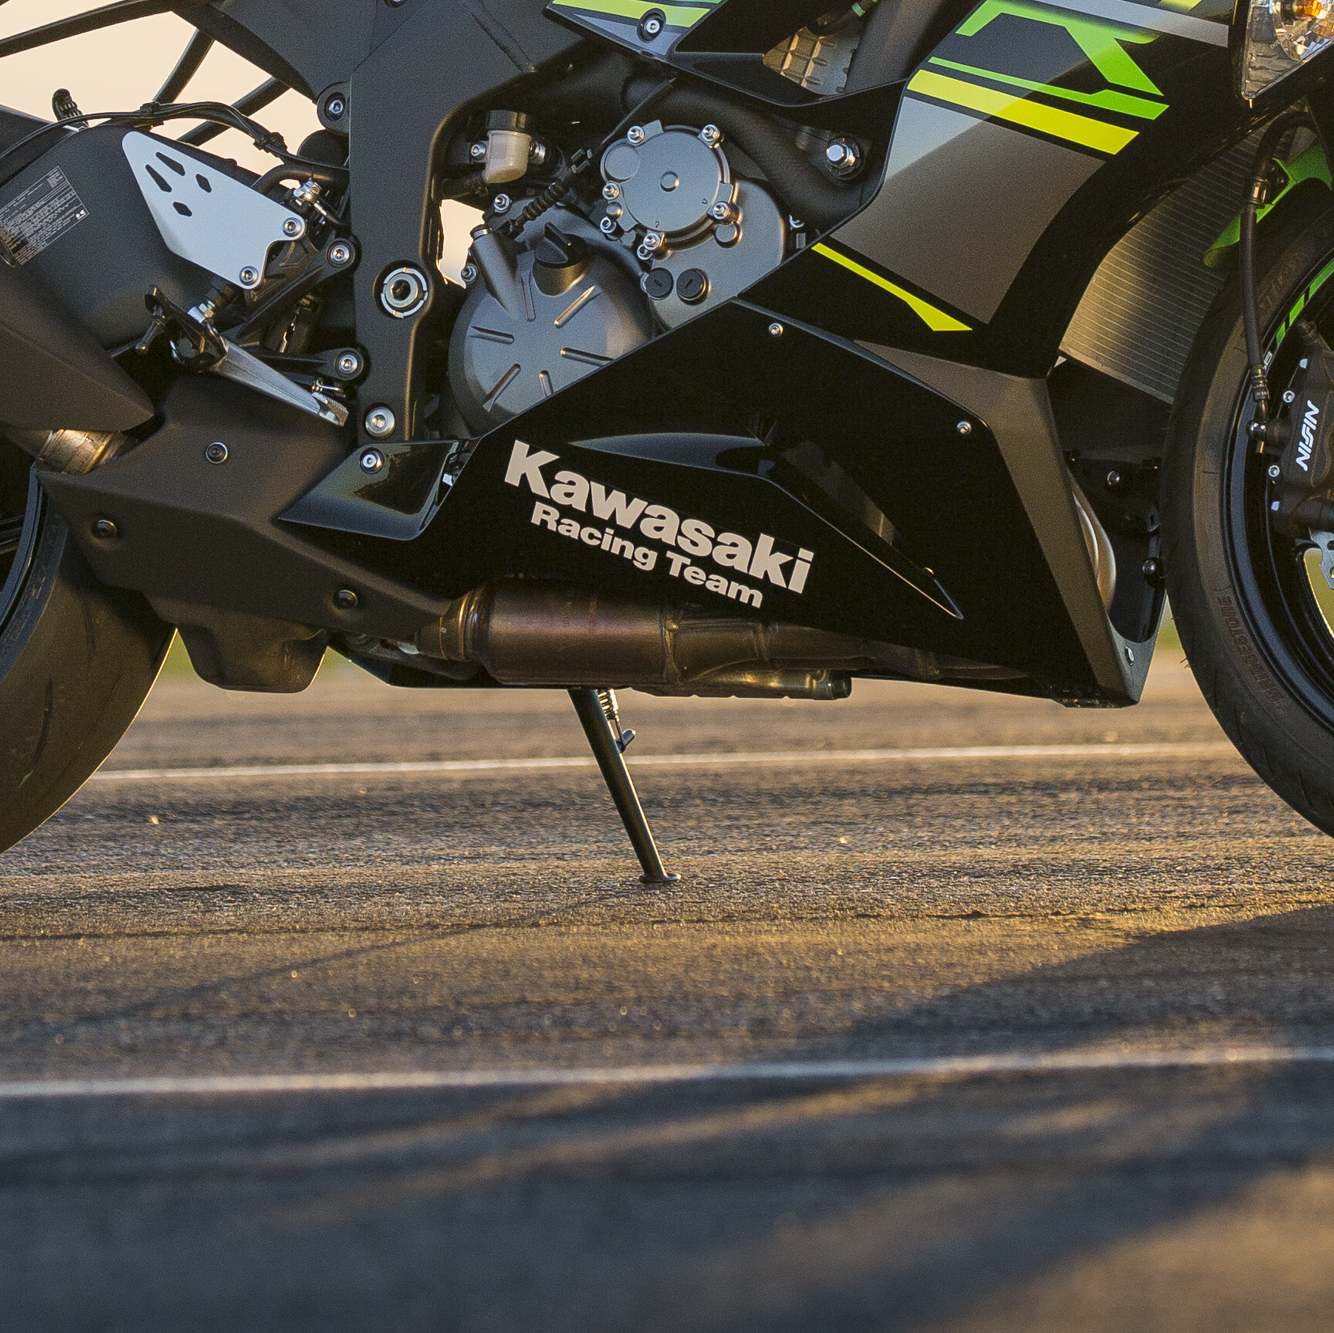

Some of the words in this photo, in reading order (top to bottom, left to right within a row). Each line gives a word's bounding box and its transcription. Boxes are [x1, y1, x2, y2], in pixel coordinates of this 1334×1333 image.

[1295, 399, 1320, 472] NISSIN
[504, 439, 814, 594] Kawasaki
[530, 501, 658, 571] Racing
[665, 551, 764, 609] Team
